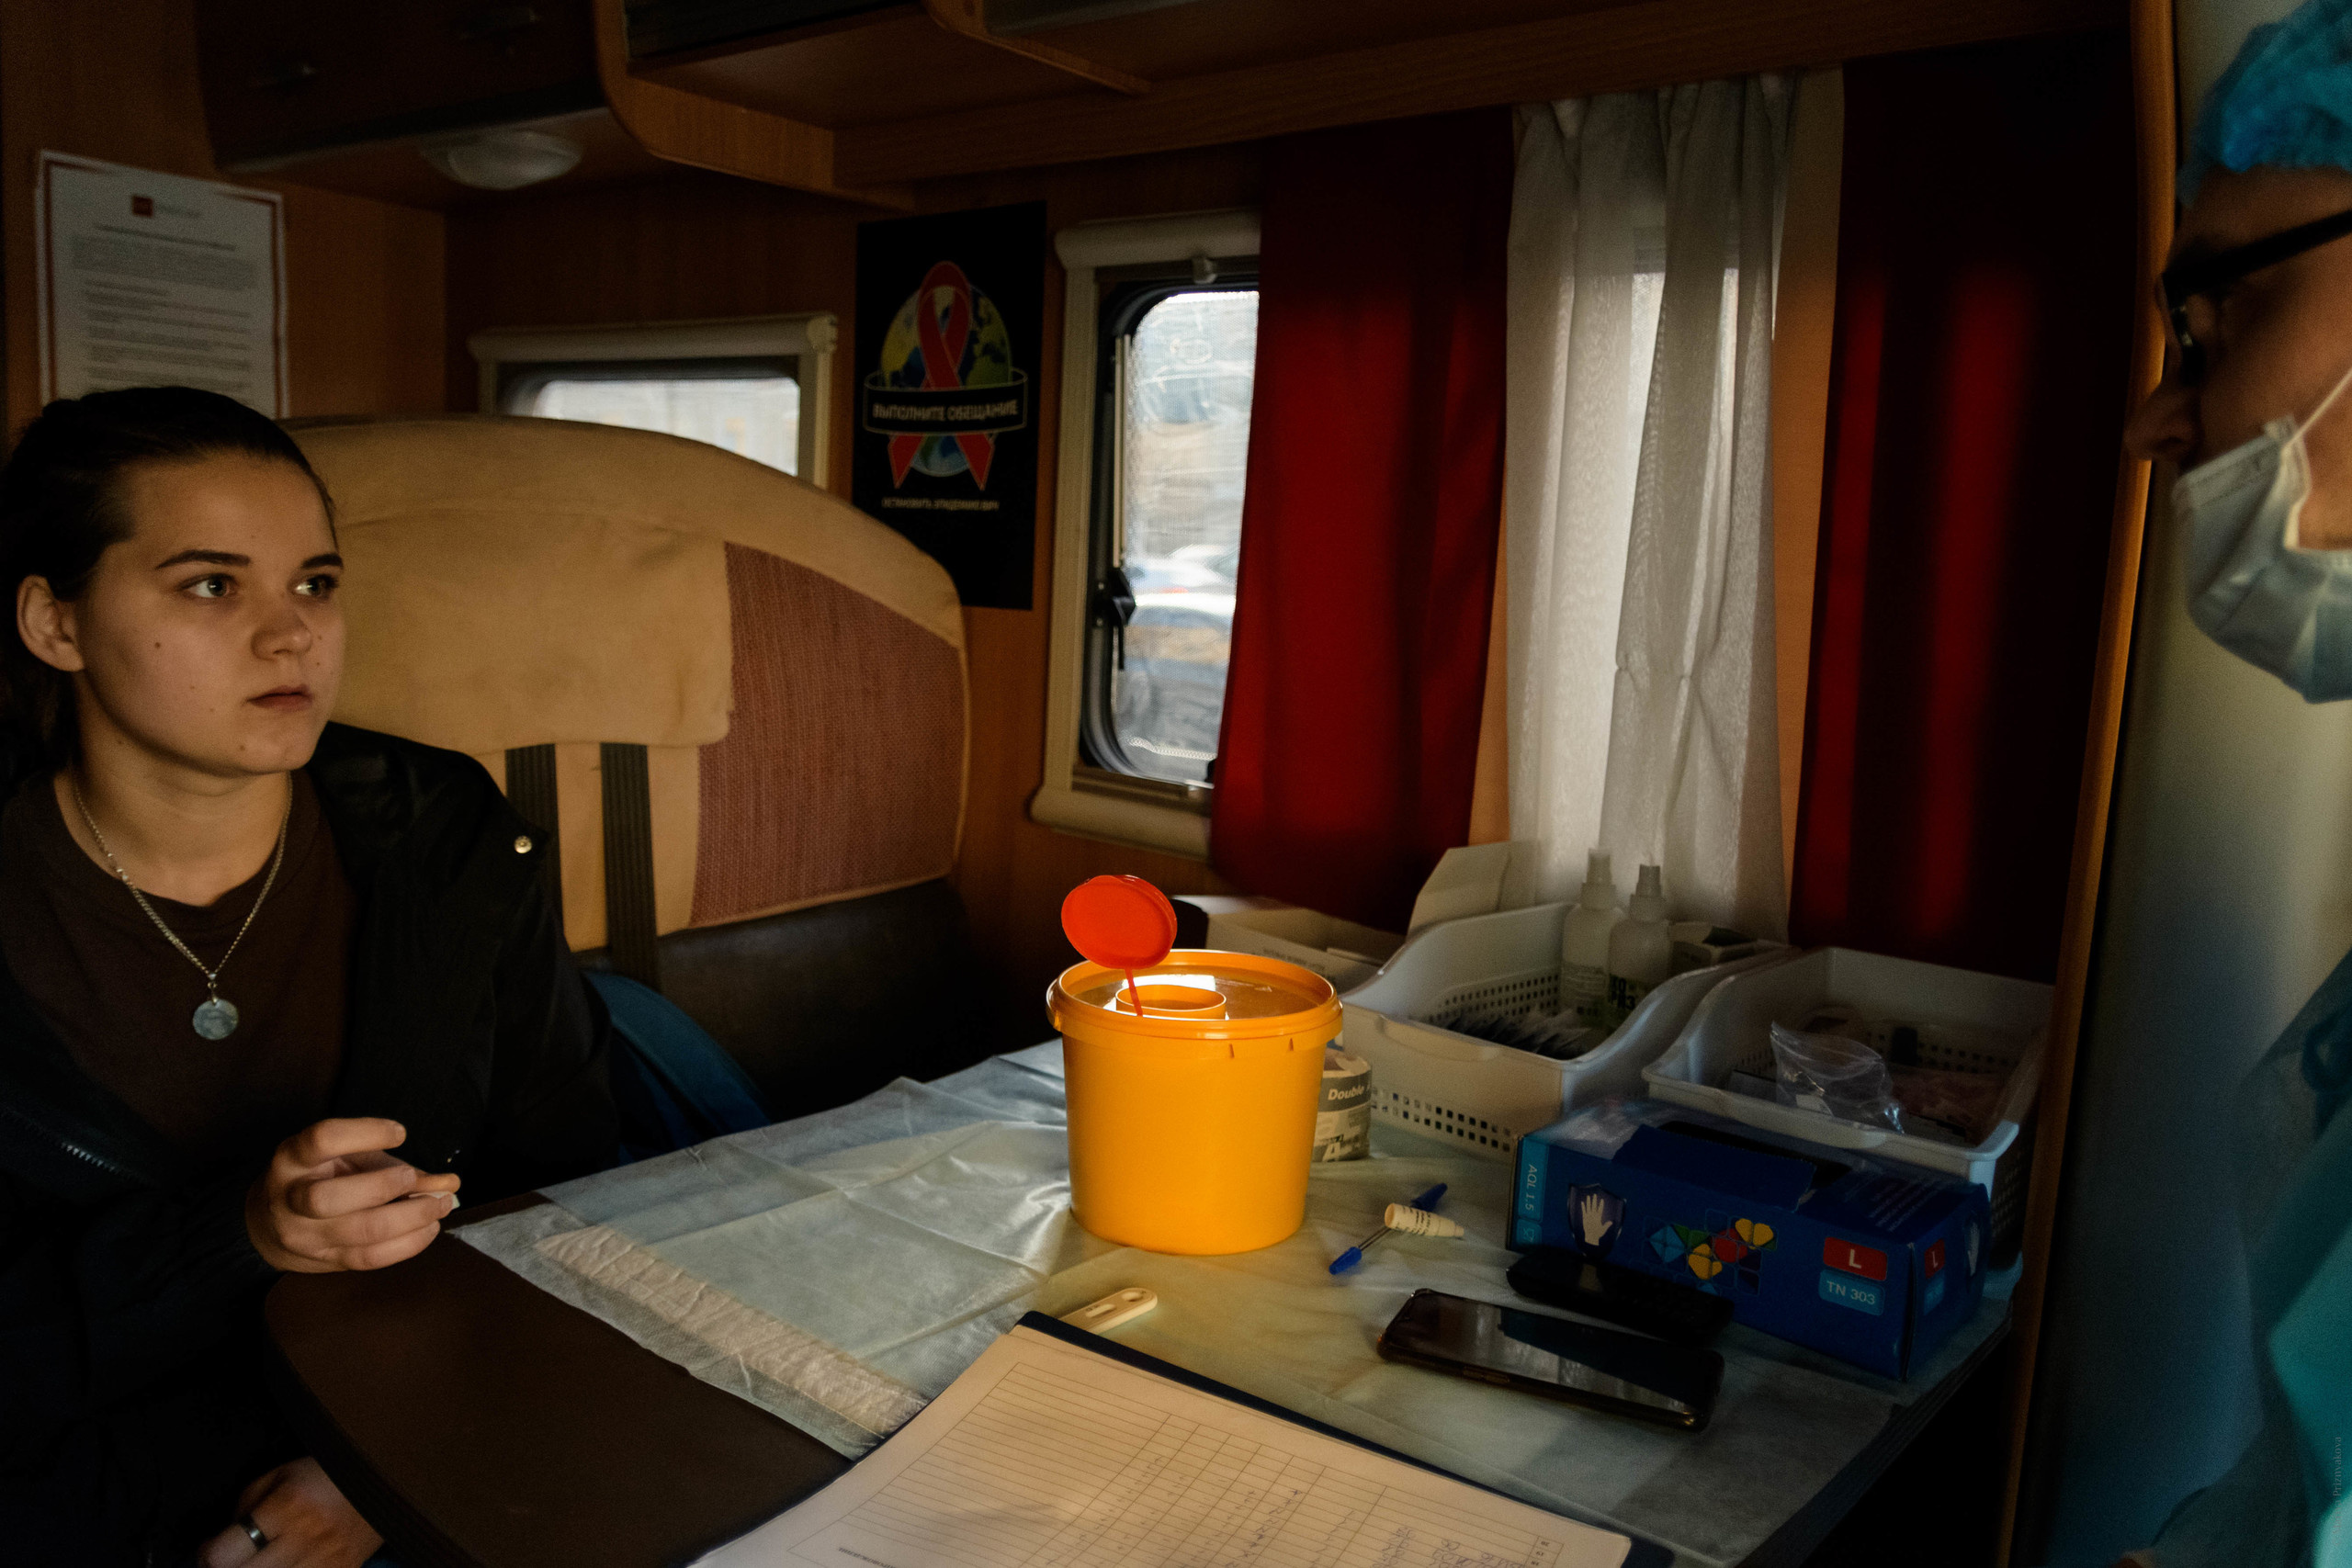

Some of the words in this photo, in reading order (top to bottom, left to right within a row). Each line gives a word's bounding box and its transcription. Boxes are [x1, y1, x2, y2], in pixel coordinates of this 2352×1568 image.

[872, 402, 945, 422] ВЫПОЛНИТЕ
[946, 399, 1019, 422] ОБЕЩАНИЕ
[1328, 1085, 1364, 1100] Double
[1526, 1164, 1538, 1189] AQL
[1849, 1248, 1861, 1269] L
[1826, 1280, 1846, 1297] TN
[1850, 1288, 1875, 1305] 303
